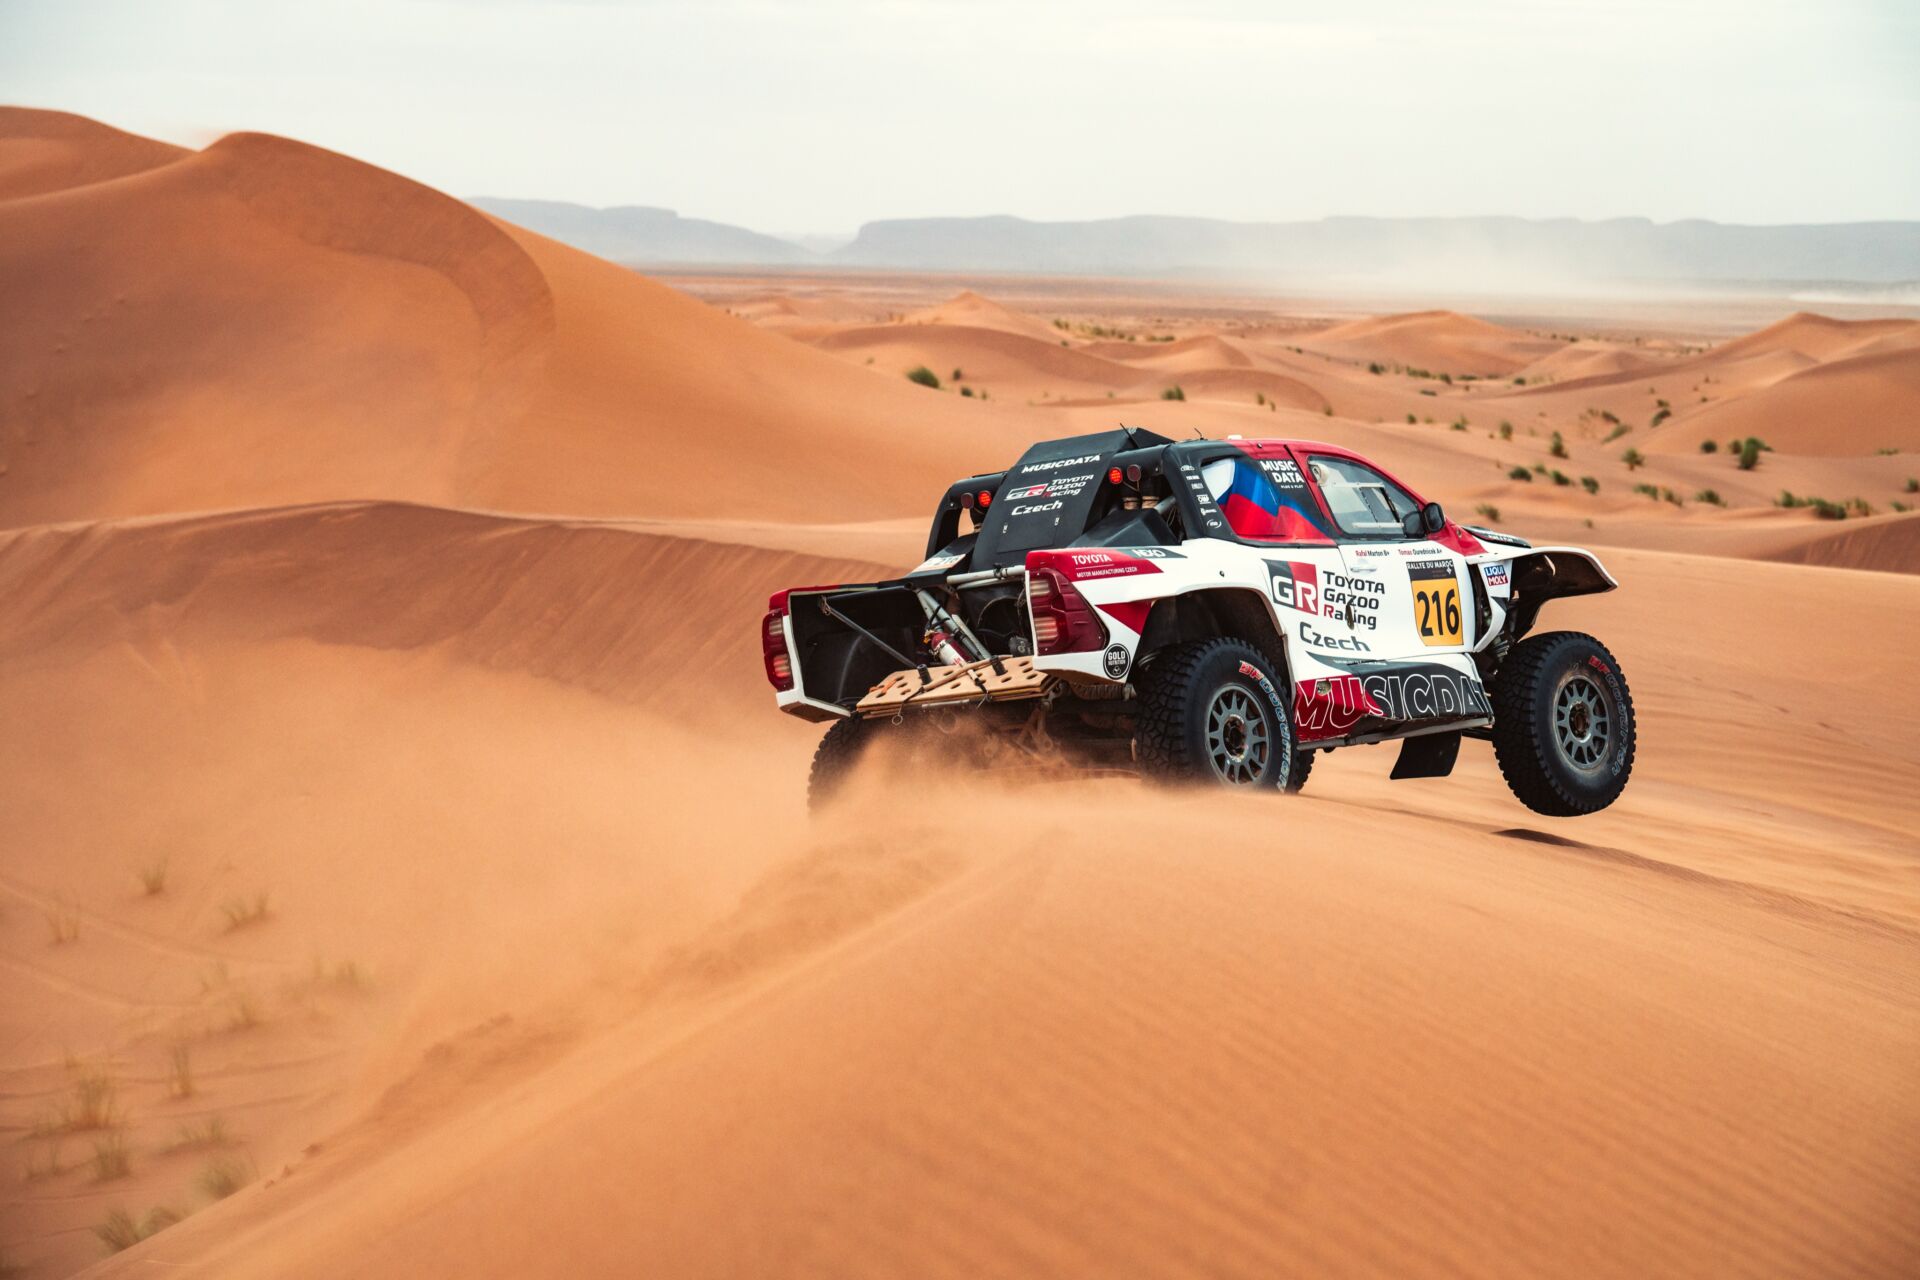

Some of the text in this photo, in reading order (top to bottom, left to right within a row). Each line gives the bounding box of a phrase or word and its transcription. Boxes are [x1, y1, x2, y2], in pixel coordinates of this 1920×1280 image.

[1021, 454, 1101, 473] MUSICDATA
[1259, 461, 1298, 471] MUSIC
[1051, 474, 1094, 486] TOYOTA
[1272, 472, 1305, 483] DATA
[1046, 482, 1087, 492] GAZOO
[1042, 488, 1081, 499] Racing
[1011, 500, 1063, 516] Czech
[1072, 554, 1112, 565] TOYOTA
[1426, 561, 1434, 569] DU
[1434, 559, 1453, 569] MAROC
[1091, 567, 1125, 576] MANUFACTURING
[1485, 565, 1504, 576] LIQUI
[1323, 570, 1385, 594] TOYOTA
[1488, 576, 1508, 586] MOLY
[1272, 575, 1318, 613] GR
[1324, 588, 1379, 610] GAZOO
[1416, 588, 1460, 637] 216
[1300, 621, 1371, 652] Czech
[1107, 650, 1126, 661] GOLD
